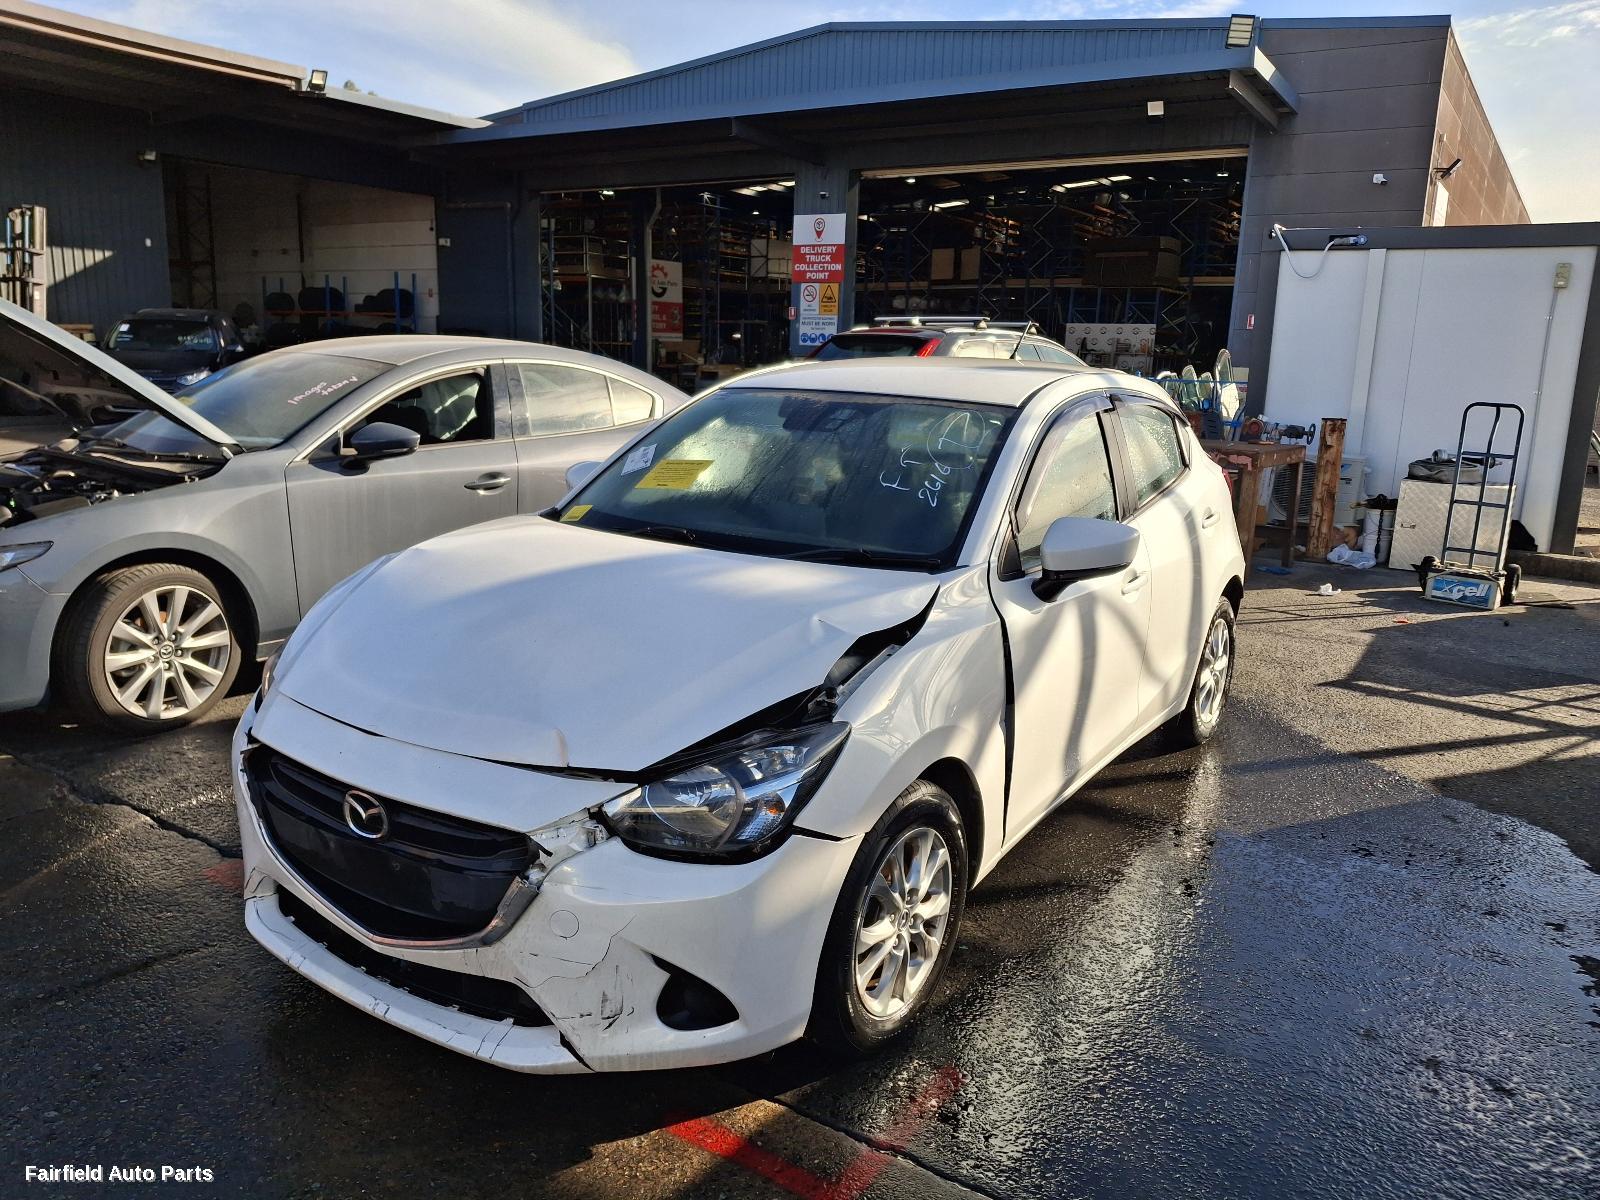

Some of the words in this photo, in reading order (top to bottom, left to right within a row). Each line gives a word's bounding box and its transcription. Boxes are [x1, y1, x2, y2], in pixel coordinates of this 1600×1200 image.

[800, 246, 837, 254] DELIVERY
[794, 263, 842, 271] COLLECTION
[806, 272, 830, 280] POINT
